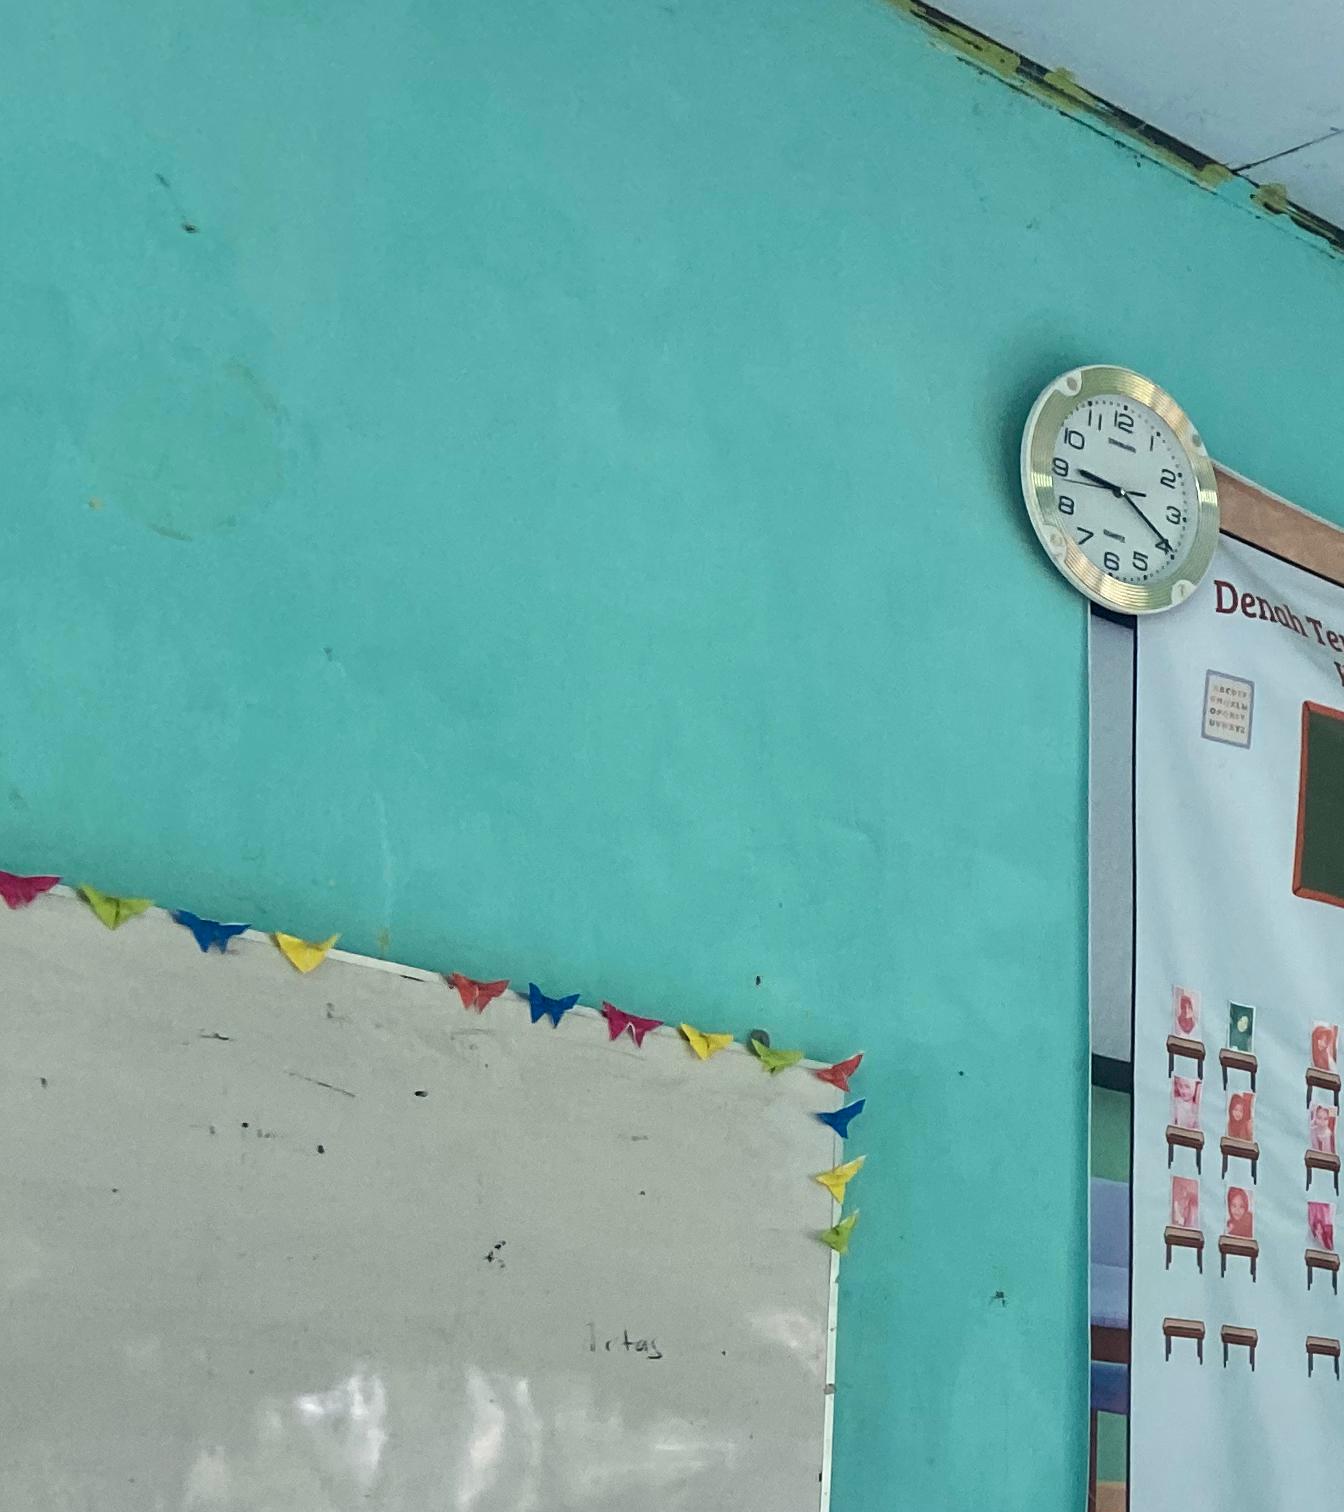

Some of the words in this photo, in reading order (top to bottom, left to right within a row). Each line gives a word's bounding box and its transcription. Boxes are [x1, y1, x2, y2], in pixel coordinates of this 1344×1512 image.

[1114, 410, 1134, 433] 12
[1064, 427, 1085, 450] 10
[1149, 435, 1155, 451] 1
[1052, 458, 1069, 477] 9
[1160, 468, 1176, 489] 2
[1058, 496, 1075, 515] 8
[1166, 505, 1182, 525] 3
[1077, 527, 1094, 545] 7
[1104, 551, 1120, 571] 6
[1132, 551, 1149, 571] 5
[1213, 580, 1308, 638] Denah
